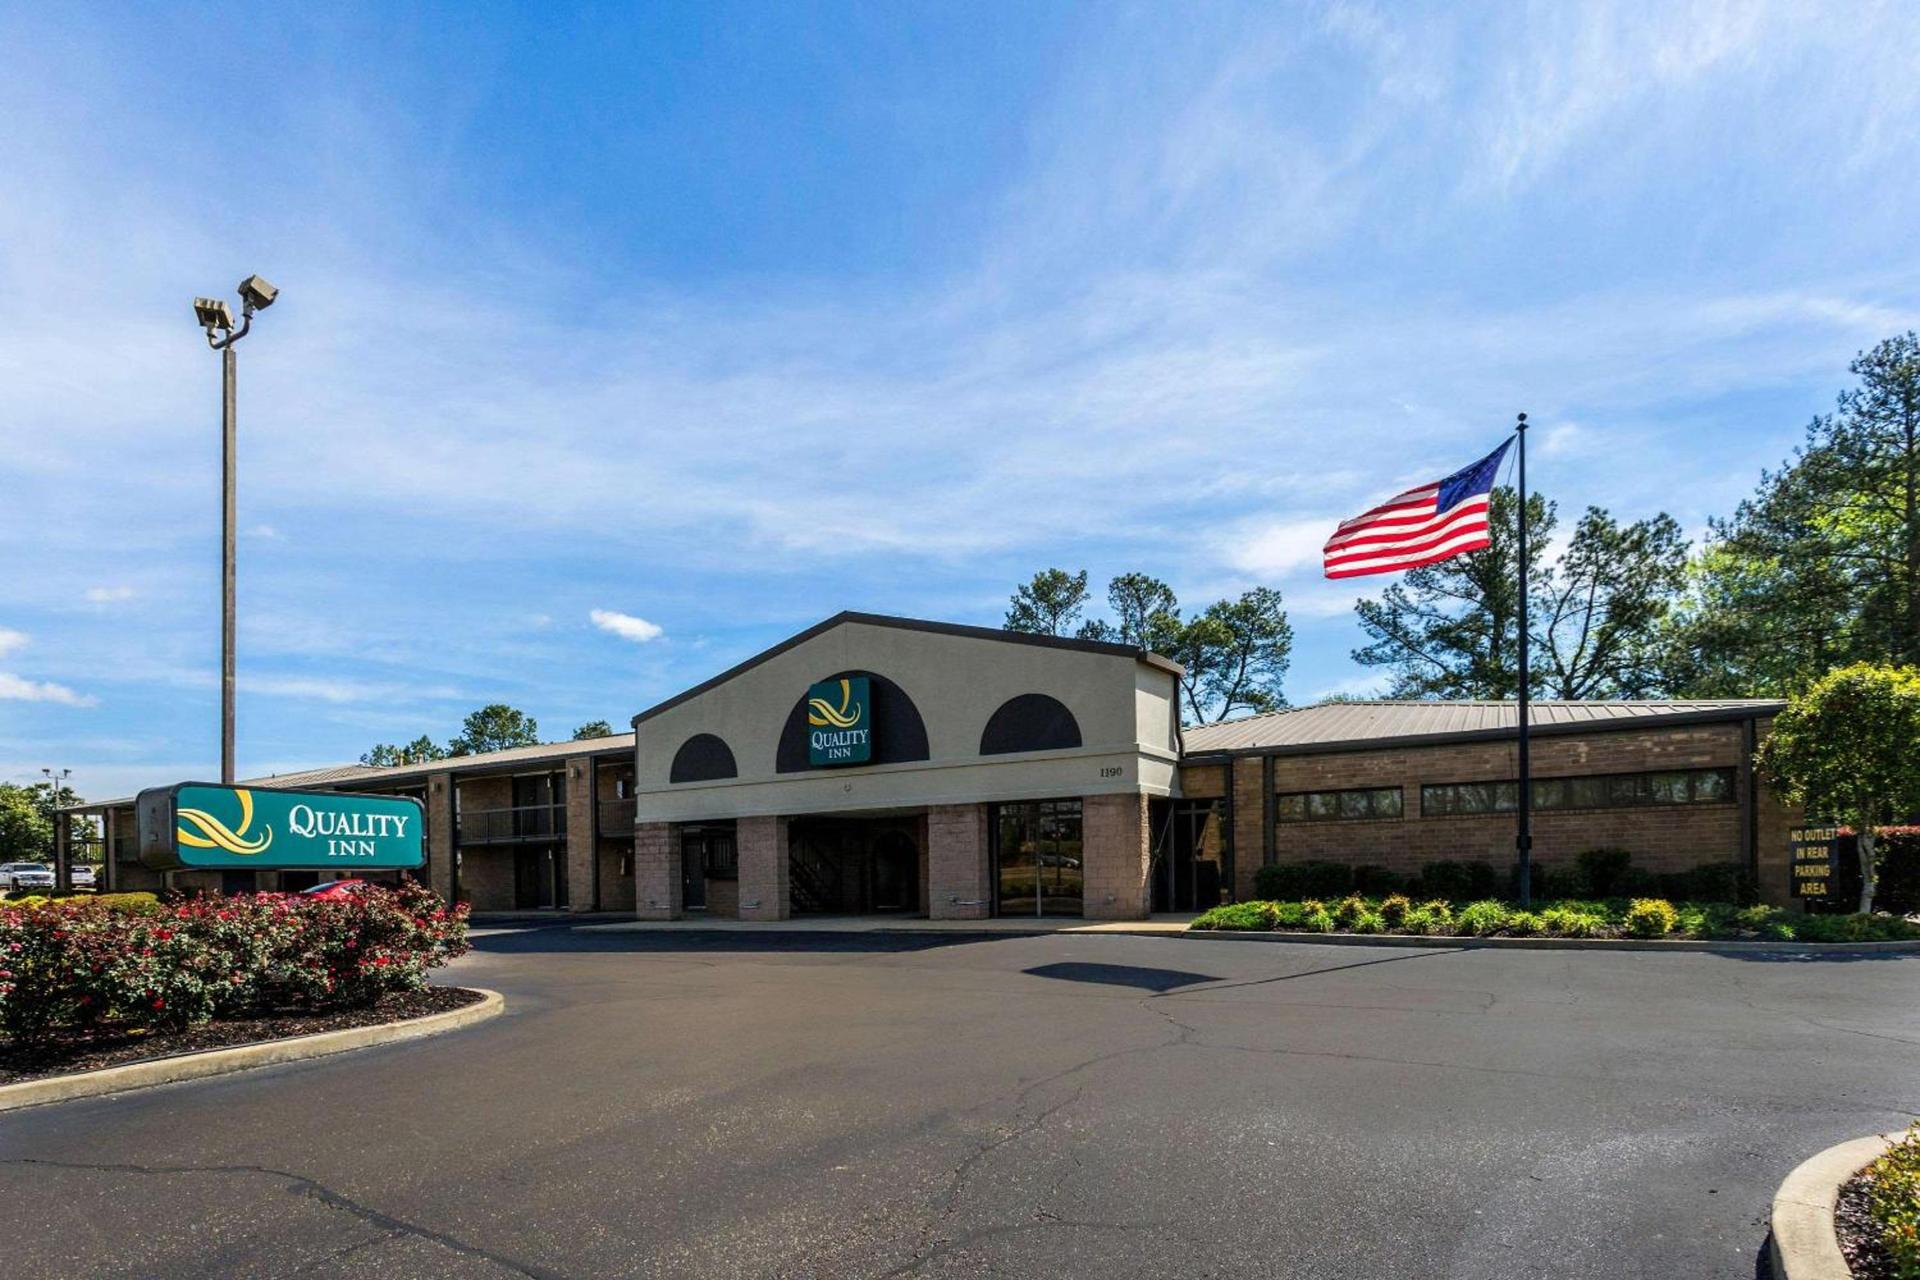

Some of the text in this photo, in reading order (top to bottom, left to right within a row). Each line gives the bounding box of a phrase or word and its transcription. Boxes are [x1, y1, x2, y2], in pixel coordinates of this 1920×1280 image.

[812, 729, 868, 750] QUALITY
[829, 747, 851, 758] INN
[1100, 767, 1122, 777] 1190
[289, 804, 408, 838] QUALITY
[1791, 828, 1836, 841] NO OUTLET
[328, 840, 375, 856] INN
[1796, 846, 1829, 859] IN REAR
[1795, 864, 1831, 877] PARKING
[1800, 882, 1828, 895] AREA
